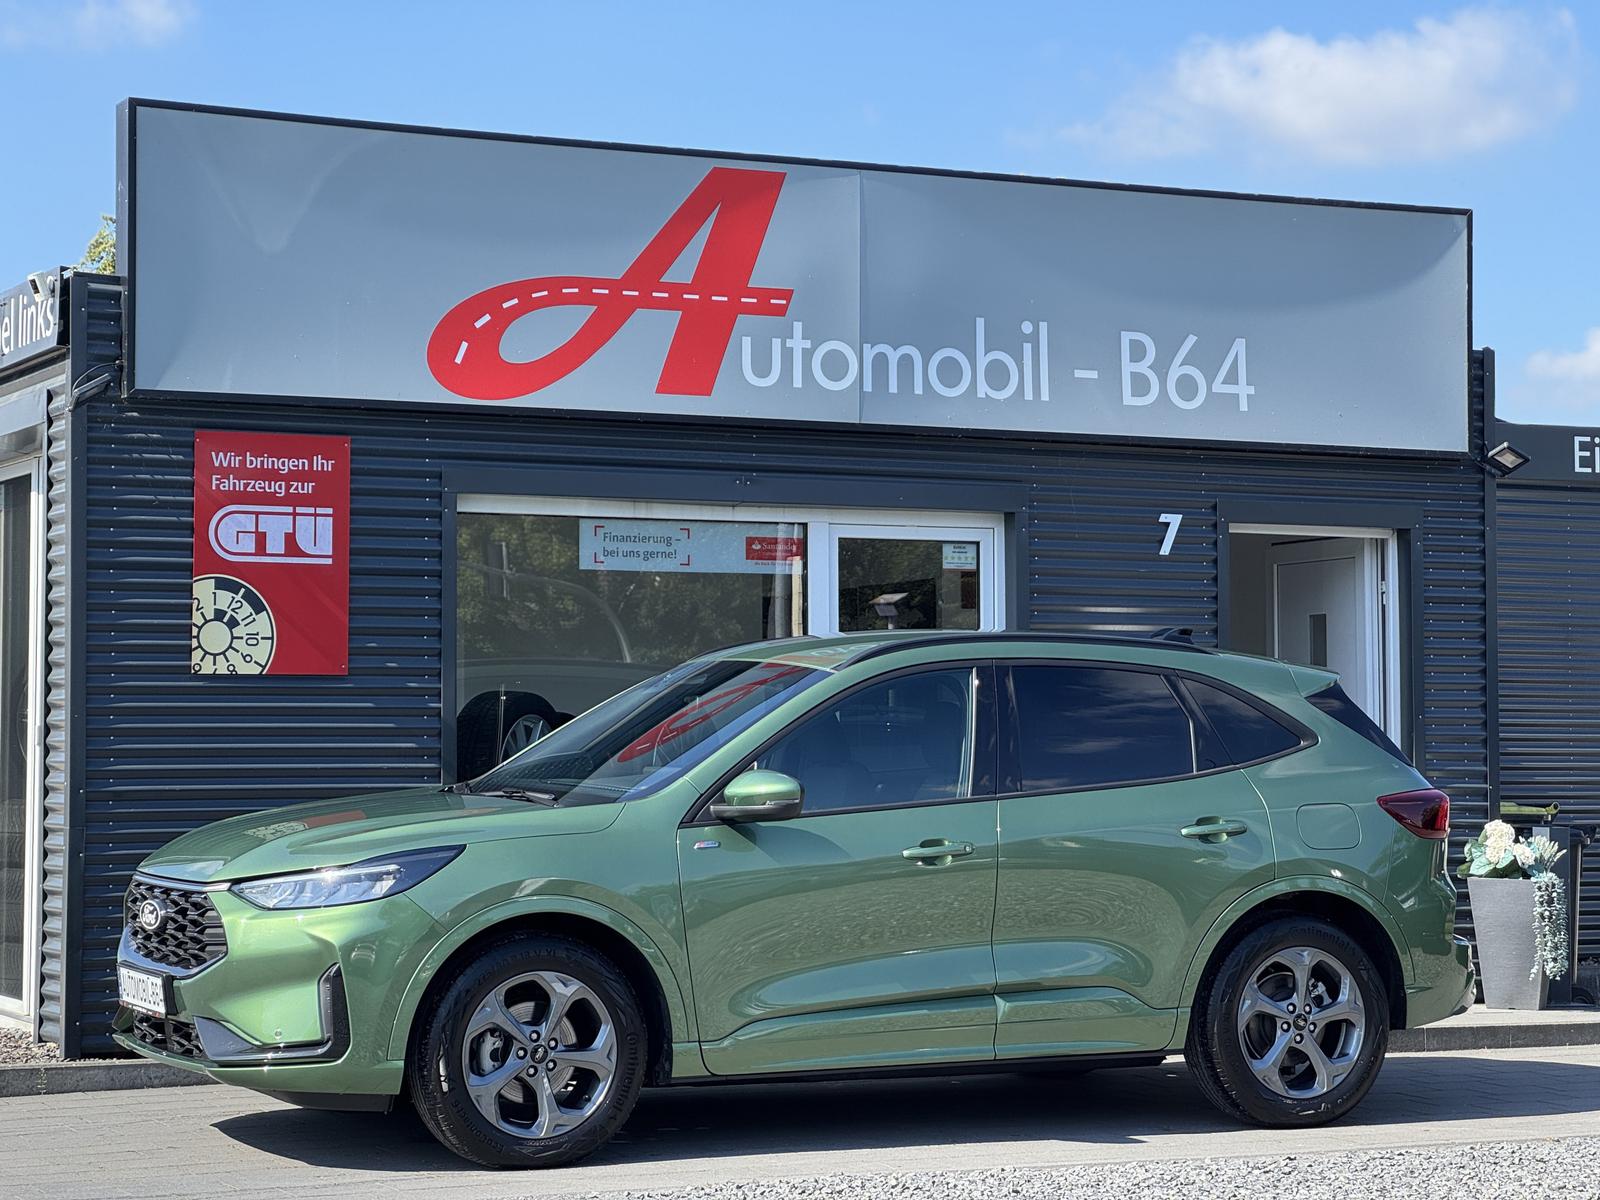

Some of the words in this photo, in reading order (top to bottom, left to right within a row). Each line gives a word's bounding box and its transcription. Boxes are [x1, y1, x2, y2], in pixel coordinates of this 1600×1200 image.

[427, 166, 1050, 402] Automobil
[1074, 368, 1099, 379] -
[1120, 331, 1255, 412] B64
[0, 298, 14, 354] el
[18, 294, 54, 348] links
[211, 452, 243, 468] Wir
[246, 452, 309, 474] bringen
[313, 455, 336, 472] Ihr
[211, 474, 286, 497] Fahrzeug
[289, 481, 316, 494] zur
[214, 505, 334, 557] GTÜ
[602, 531, 673, 547] Finanzierung
[1158, 513, 1183, 556] 7
[602, 546, 620, 558] bei
[622, 549, 641, 559] uns
[642, 549, 678, 561] gerne!
[227, 595, 244, 615] 12
[240, 611, 257, 628] 11
[245, 631, 260, 647] 10
